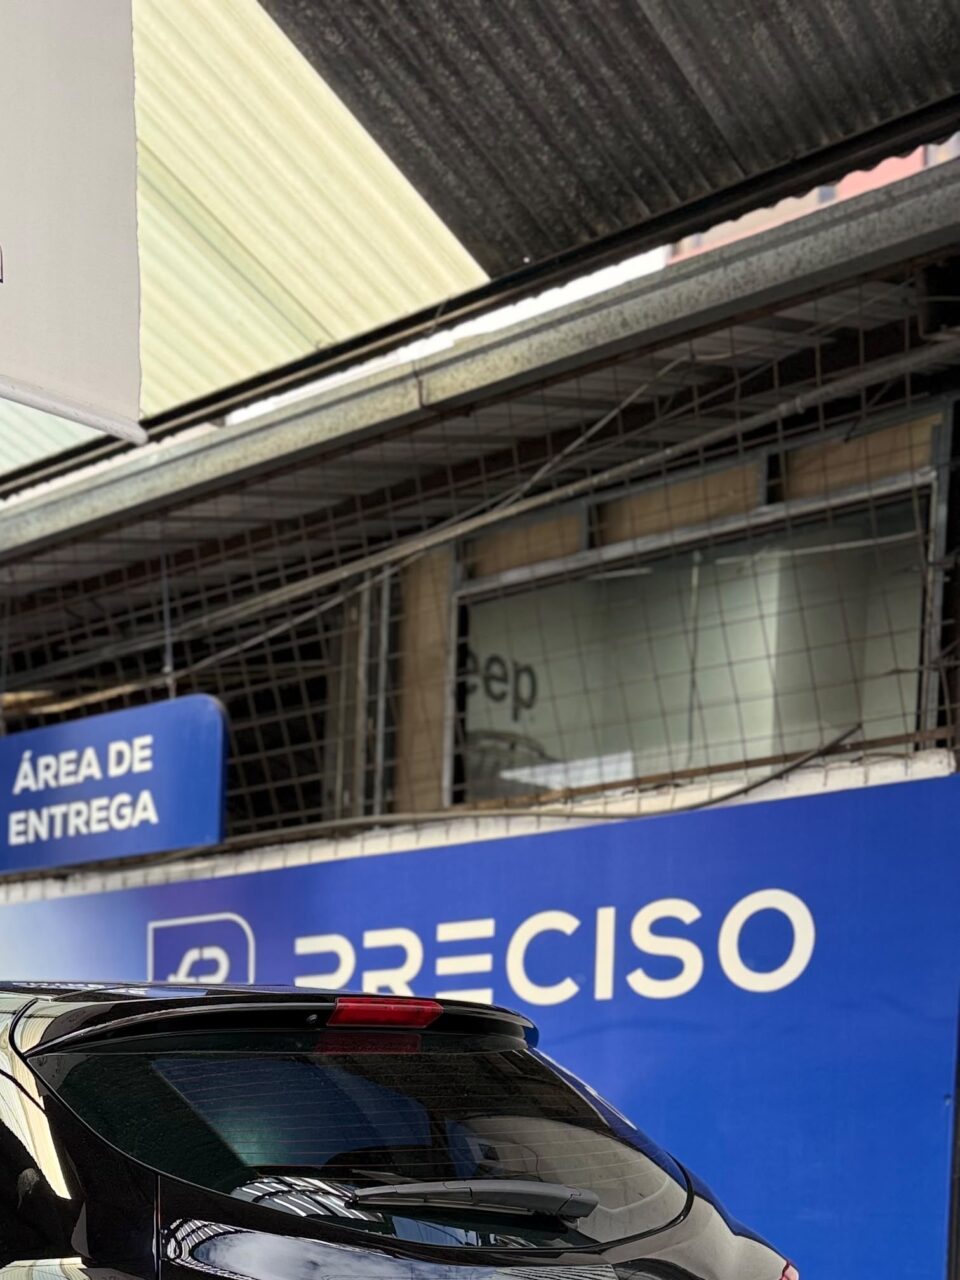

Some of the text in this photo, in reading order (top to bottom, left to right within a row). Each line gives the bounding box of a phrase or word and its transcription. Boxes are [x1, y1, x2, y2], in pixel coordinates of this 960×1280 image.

[13, 735, 153, 795] ÁREA DE
[8, 789, 159, 846] ENTREGA
[294, 888, 816, 1006] PRECISO
